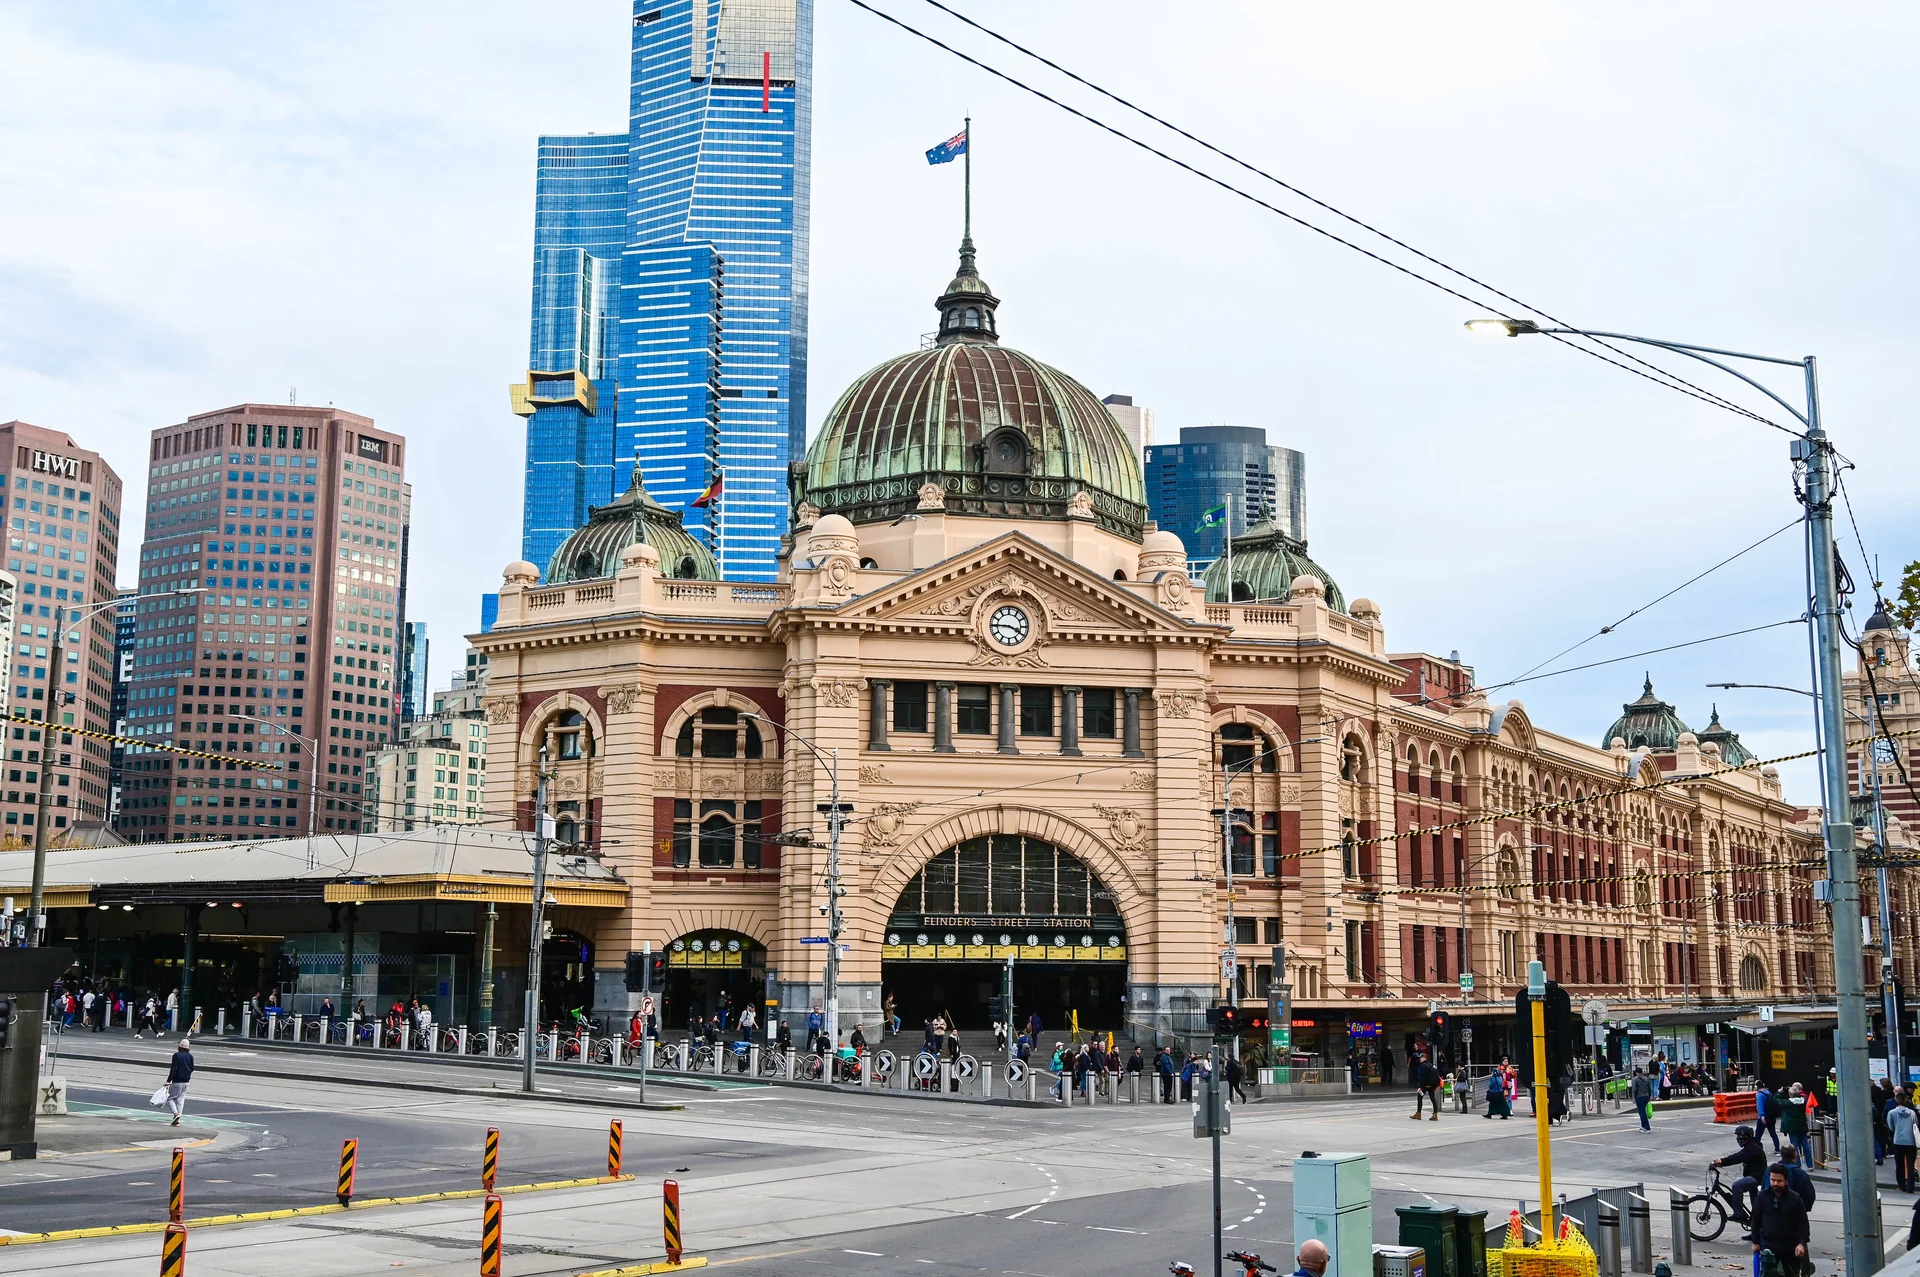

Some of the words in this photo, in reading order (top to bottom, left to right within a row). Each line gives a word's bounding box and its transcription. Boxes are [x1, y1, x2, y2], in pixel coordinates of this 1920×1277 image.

[361, 439, 380, 453] IBM
[1145, 449, 1153, 464] f
[33, 451, 80, 477] HWT
[923, 916, 977, 926] FLINDERS
[990, 917, 1031, 927] STREET
[1043, 918, 1091, 928] STATION
